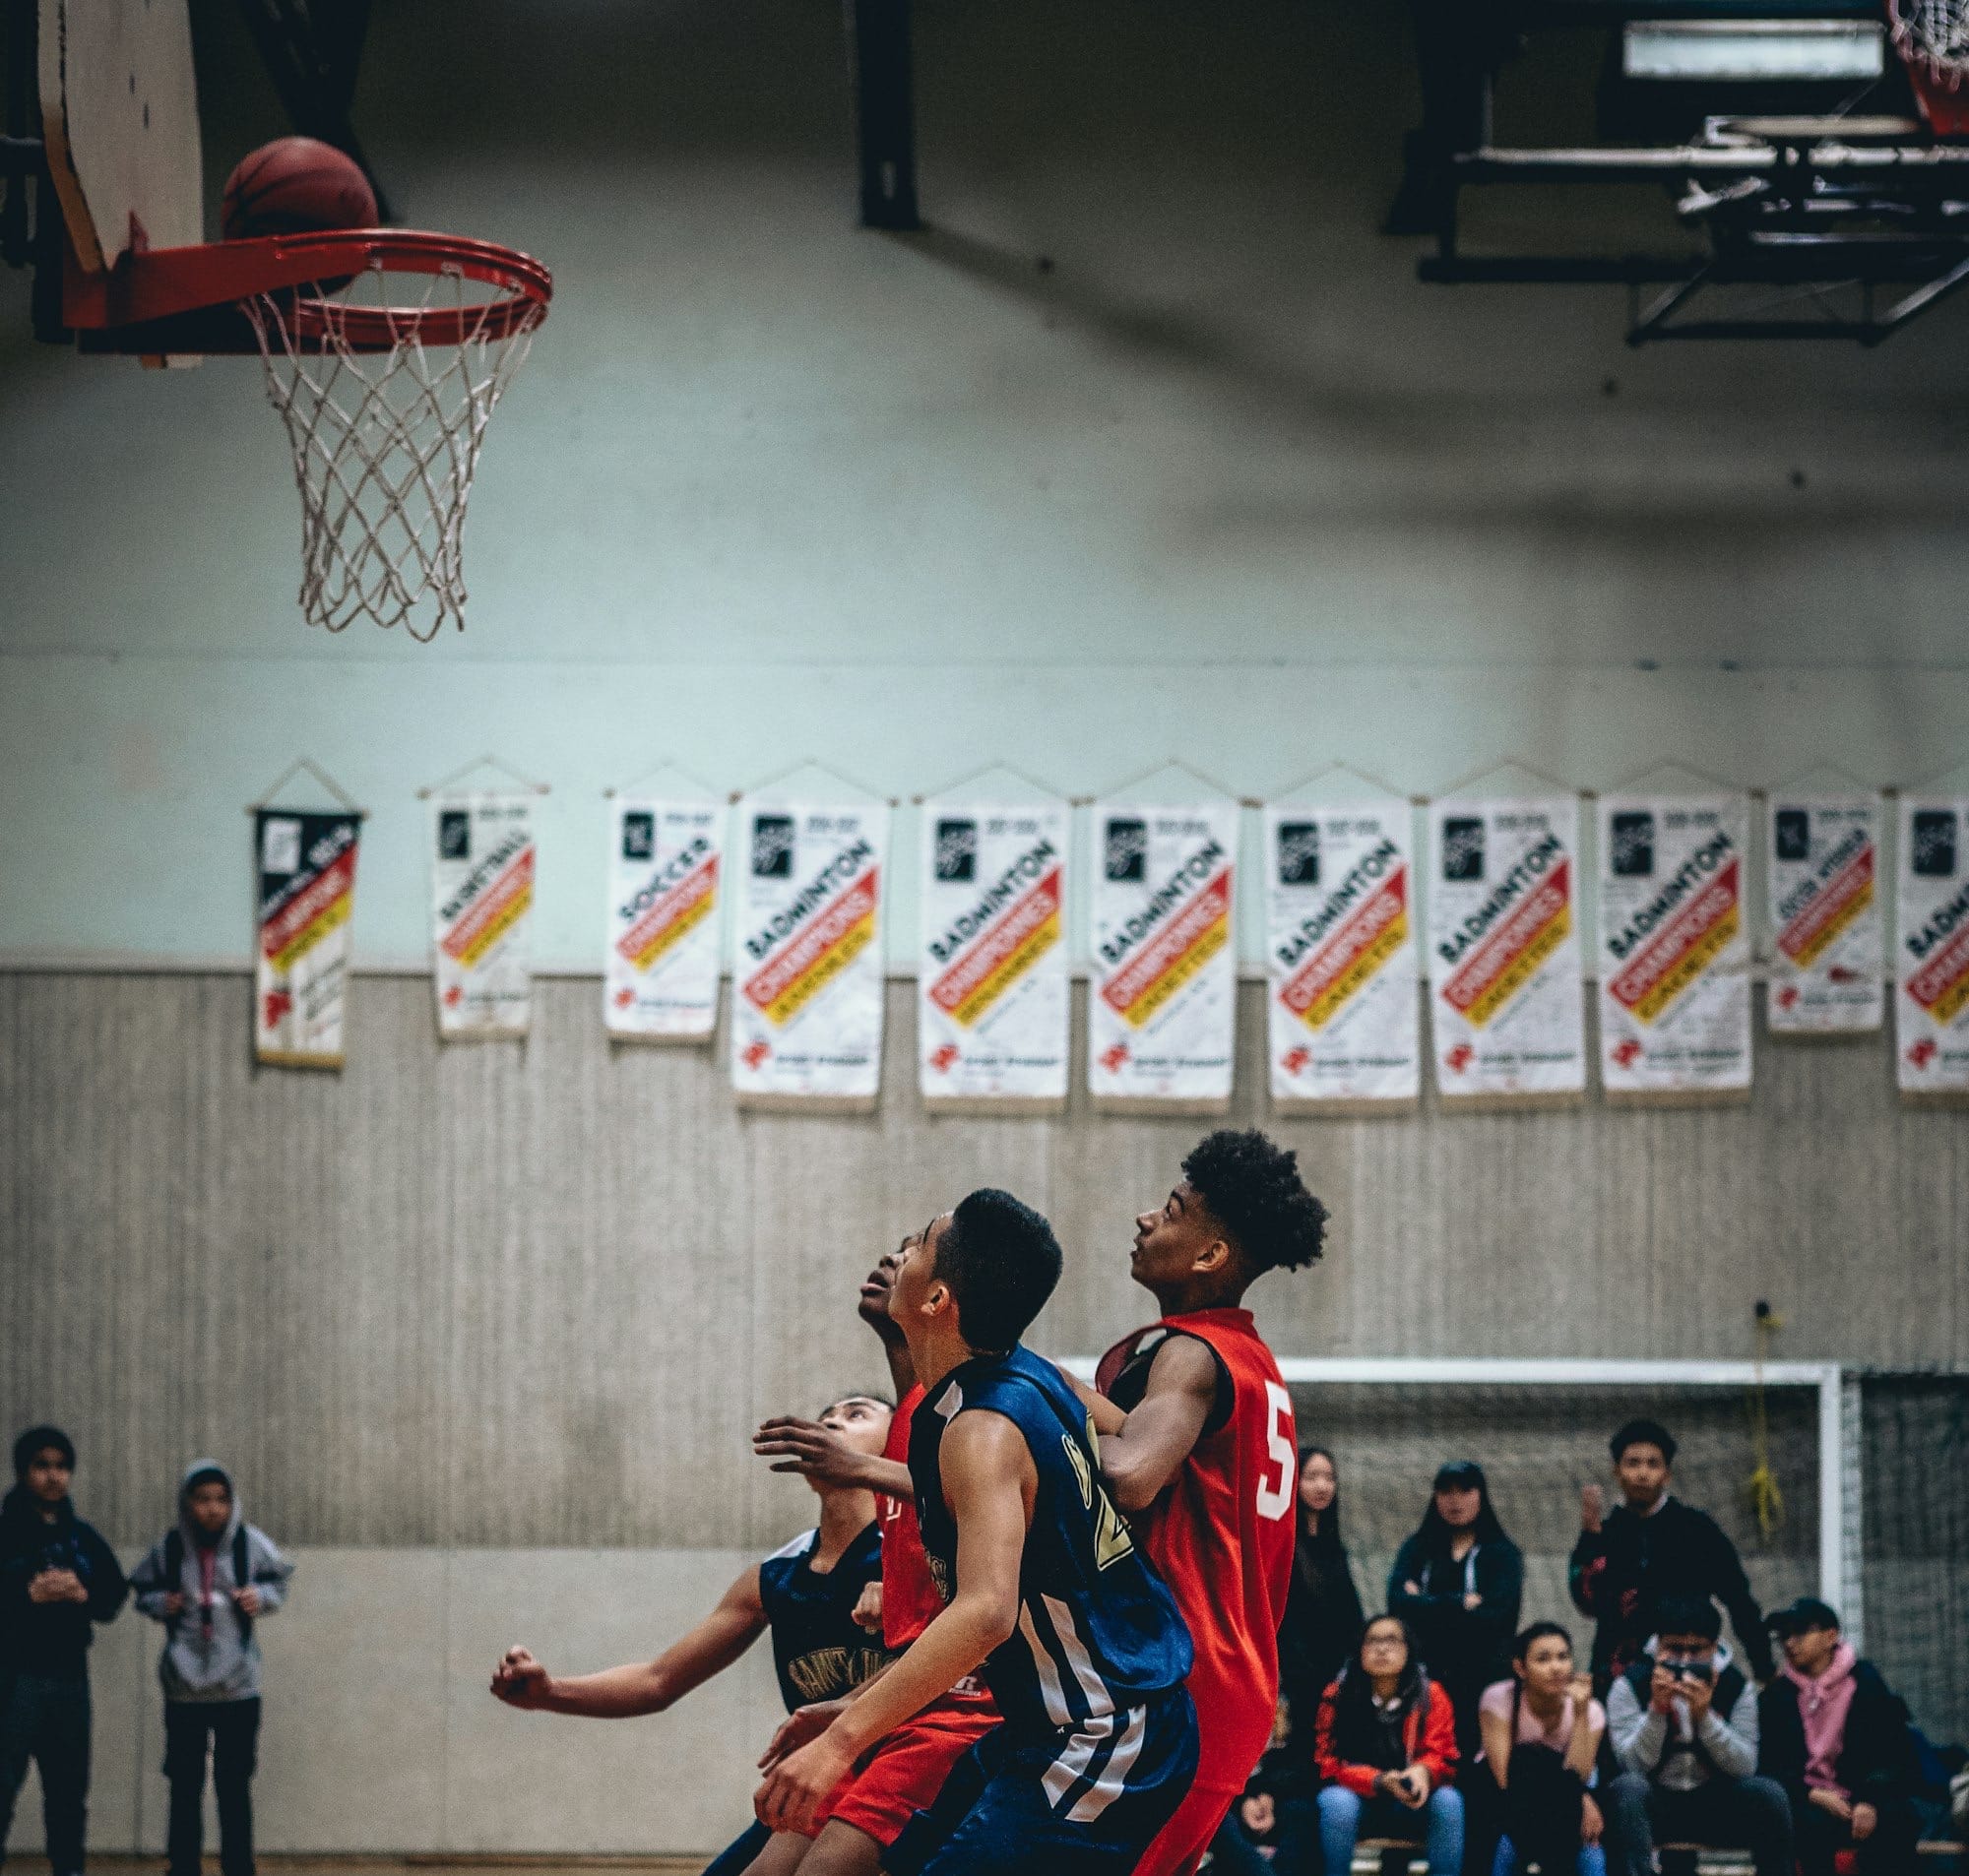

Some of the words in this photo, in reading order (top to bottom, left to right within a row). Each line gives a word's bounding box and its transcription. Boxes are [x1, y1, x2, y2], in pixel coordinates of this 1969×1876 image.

[617, 836, 710, 921] SOCCER
[745, 838, 872, 961] BADMINTON
[929, 839, 1056, 964] BADMINTON
[1101, 839, 1224, 965] BADMINTON
[1277, 839, 1399, 966] BADMINTON
[1438, 835, 1561, 964] BADMINTON
[1608, 832, 1733, 960] BADMINTON
[748, 887, 873, 1006] CHAMPIONS
[1284, 890, 1403, 1012] CHAMPIONS
[1614, 882, 1736, 1004] CHAMPIONS
[1254, 1380, 1296, 1522] 5
